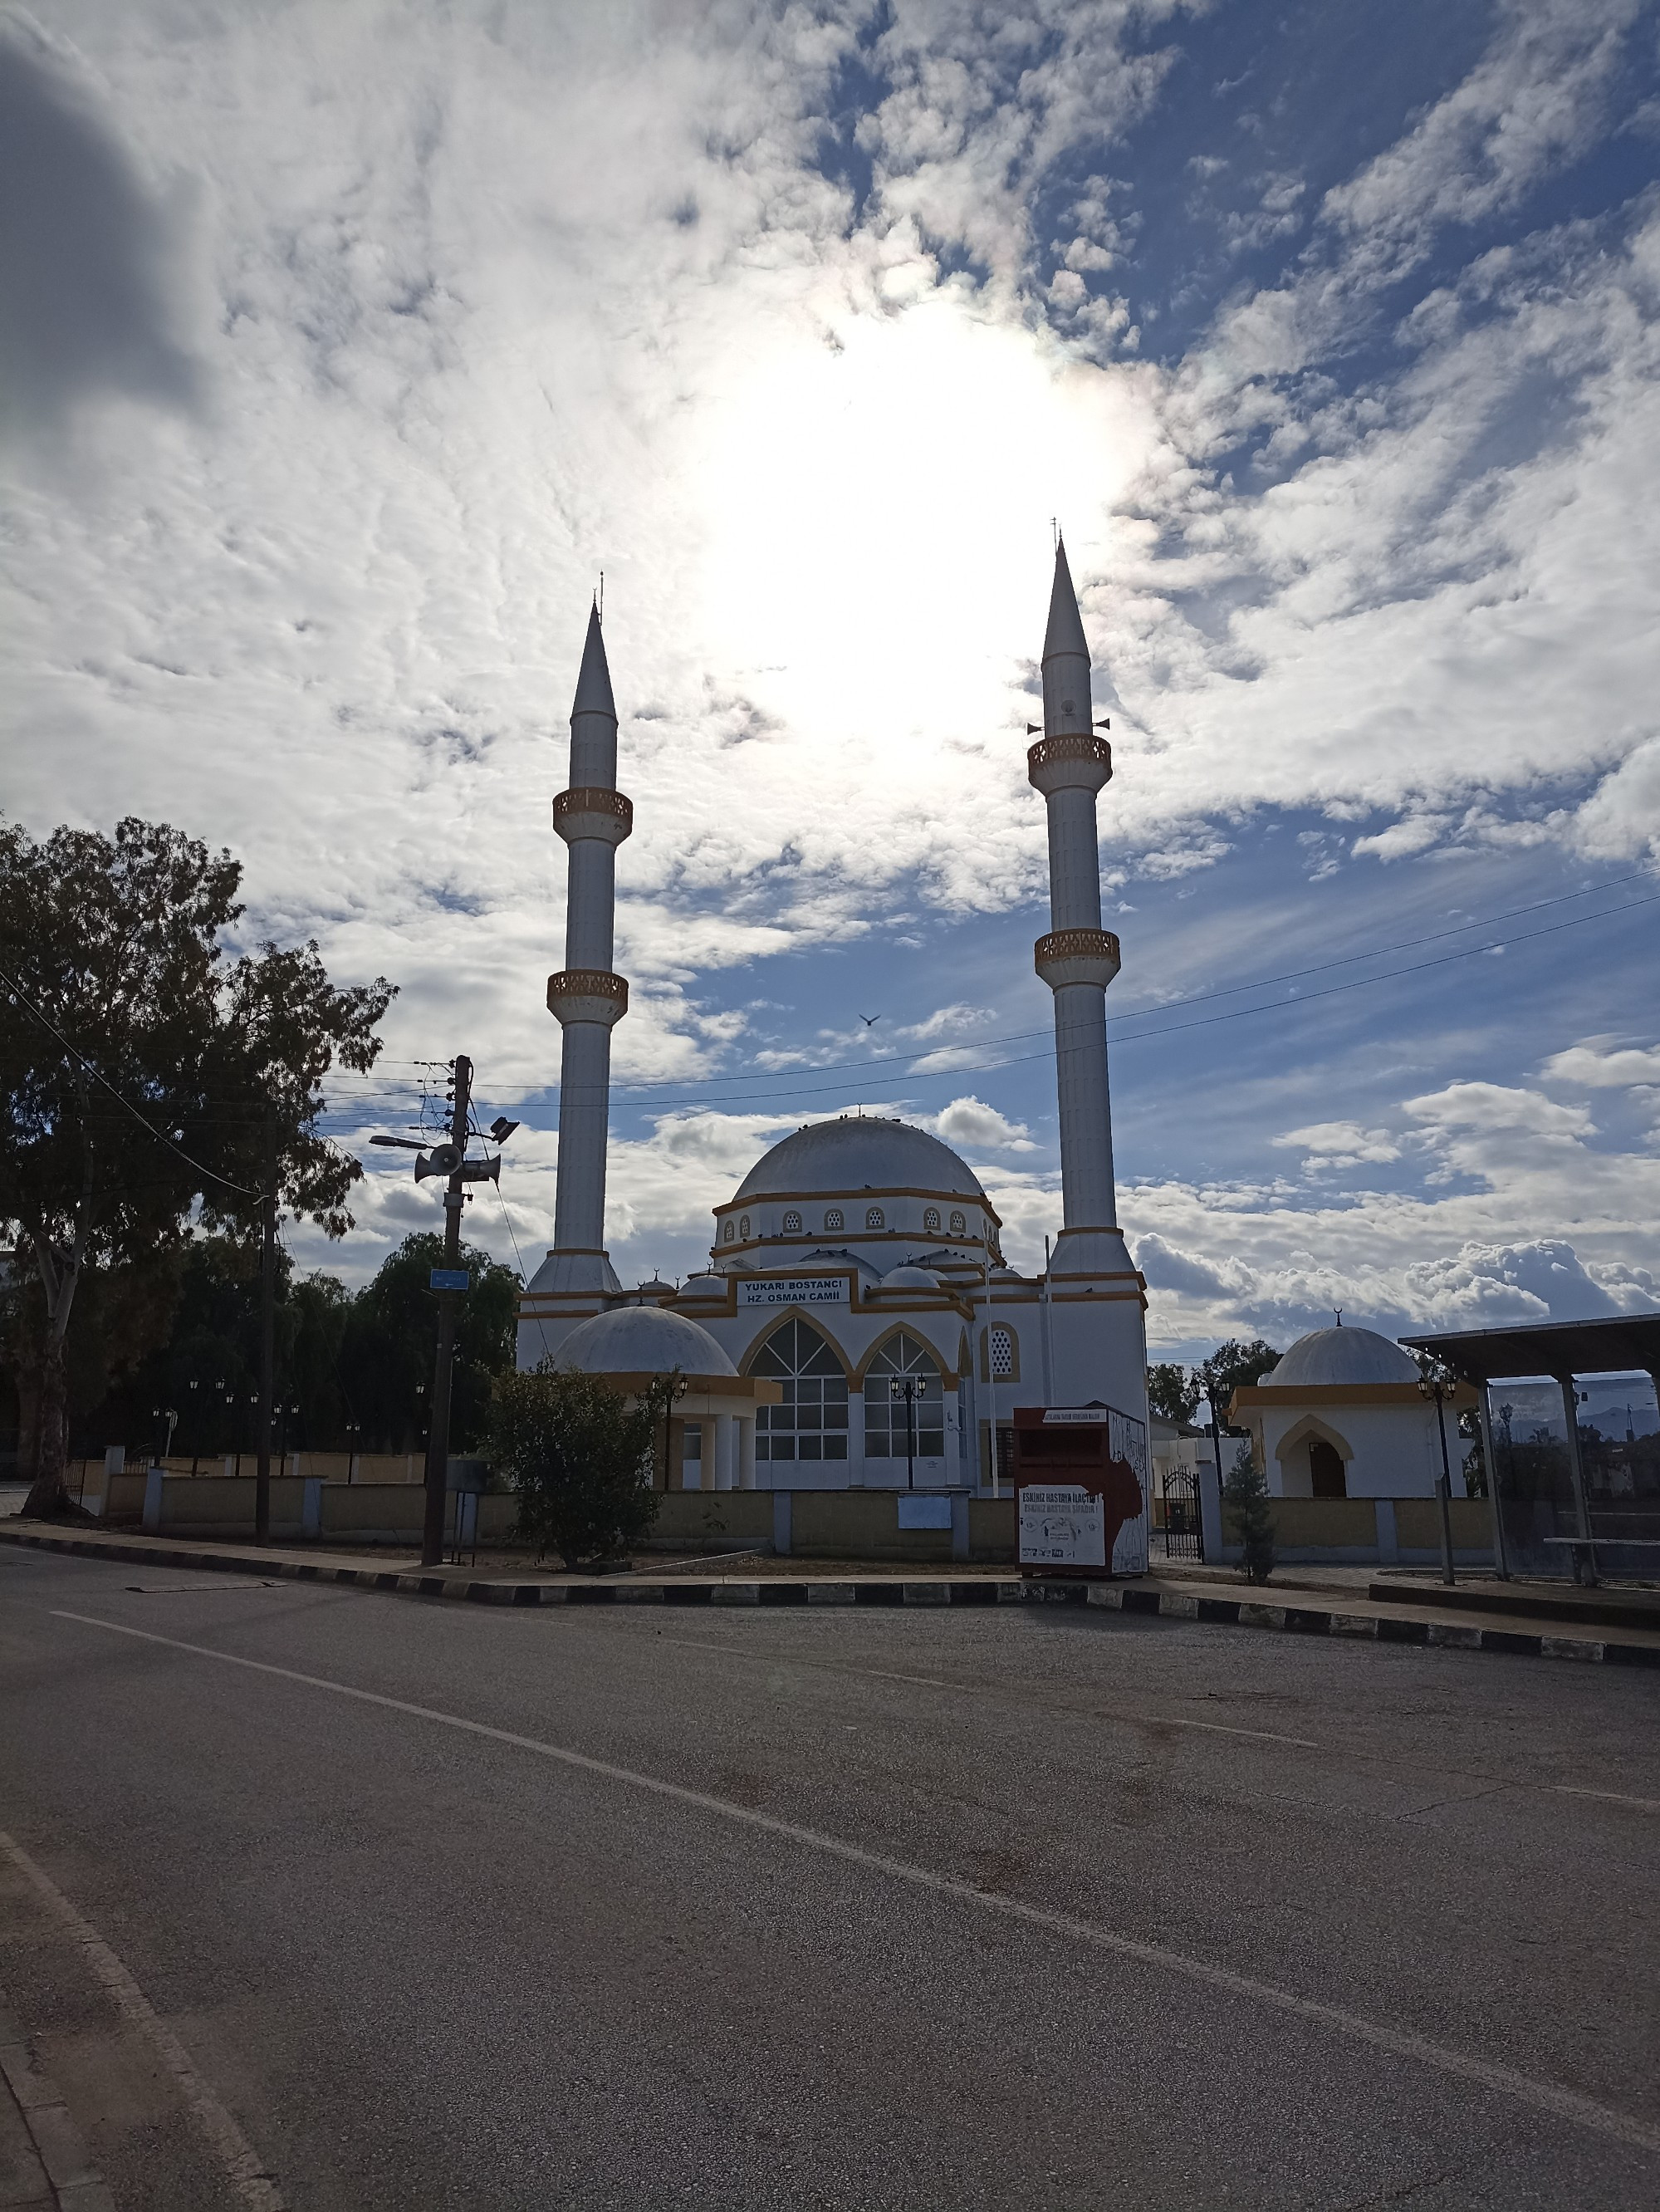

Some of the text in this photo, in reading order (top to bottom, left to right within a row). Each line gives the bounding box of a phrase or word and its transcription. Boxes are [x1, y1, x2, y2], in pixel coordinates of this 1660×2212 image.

[745, 1280, 842, 1291] YUKARI BOSTANCI
[767, 1293, 806, 1302] OSMAN
[1045, 1493, 1072, 1503] HASTAYA
